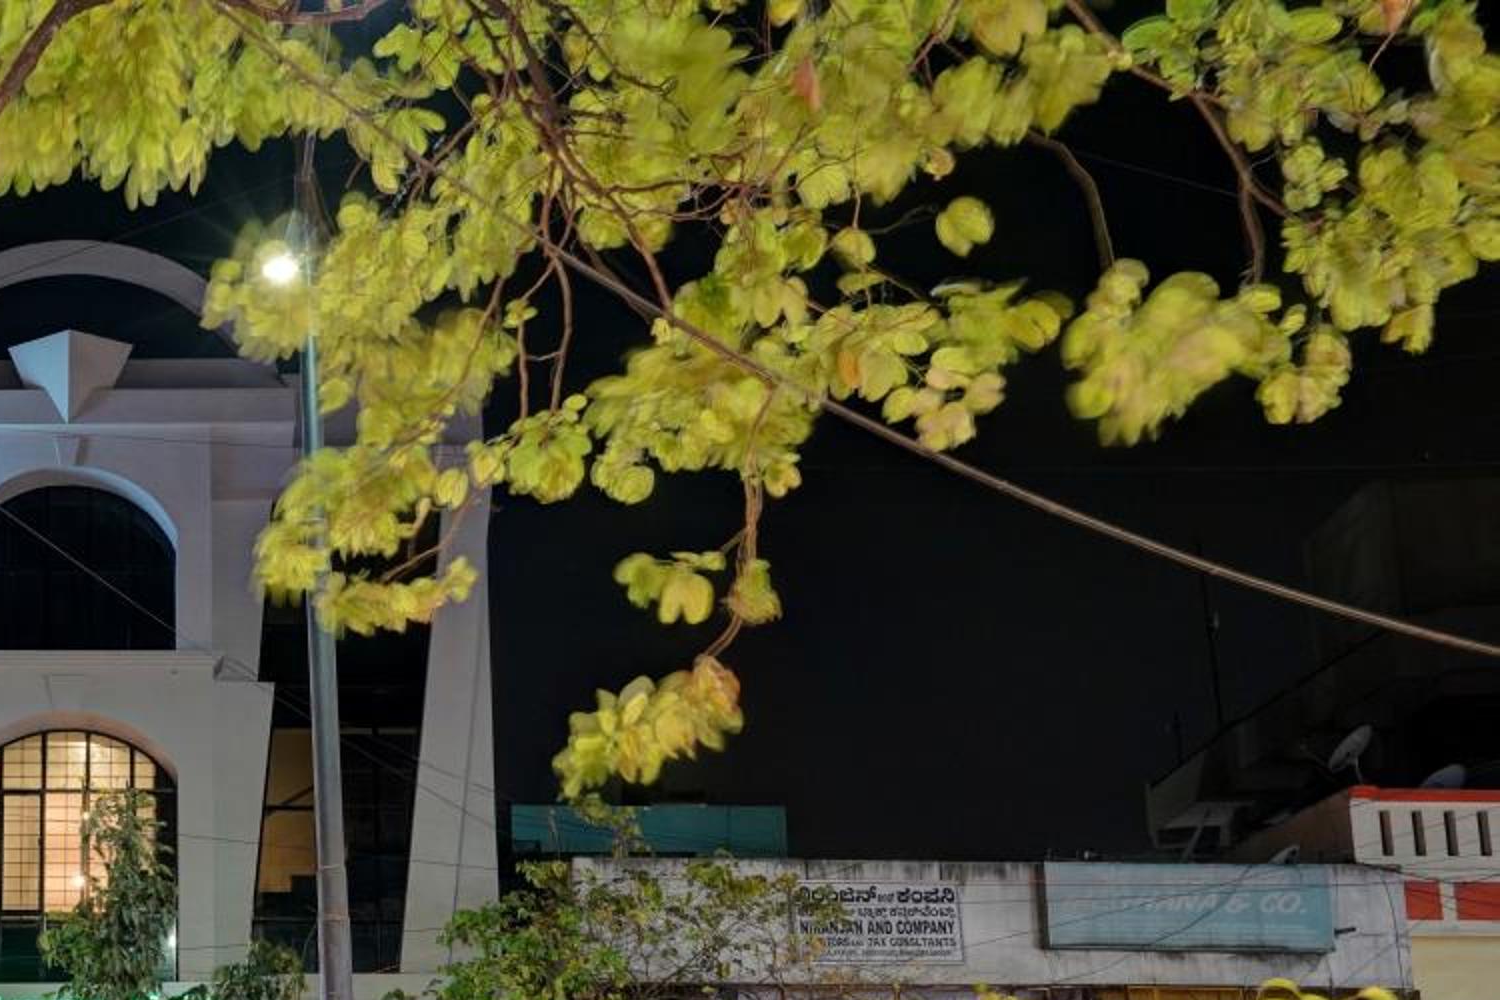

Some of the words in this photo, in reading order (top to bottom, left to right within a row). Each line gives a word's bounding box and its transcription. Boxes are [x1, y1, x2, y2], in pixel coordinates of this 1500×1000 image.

[868, 921, 892, 935] AND
[896, 920, 955, 935] COMPANY
[868, 938, 887, 947] TAX
